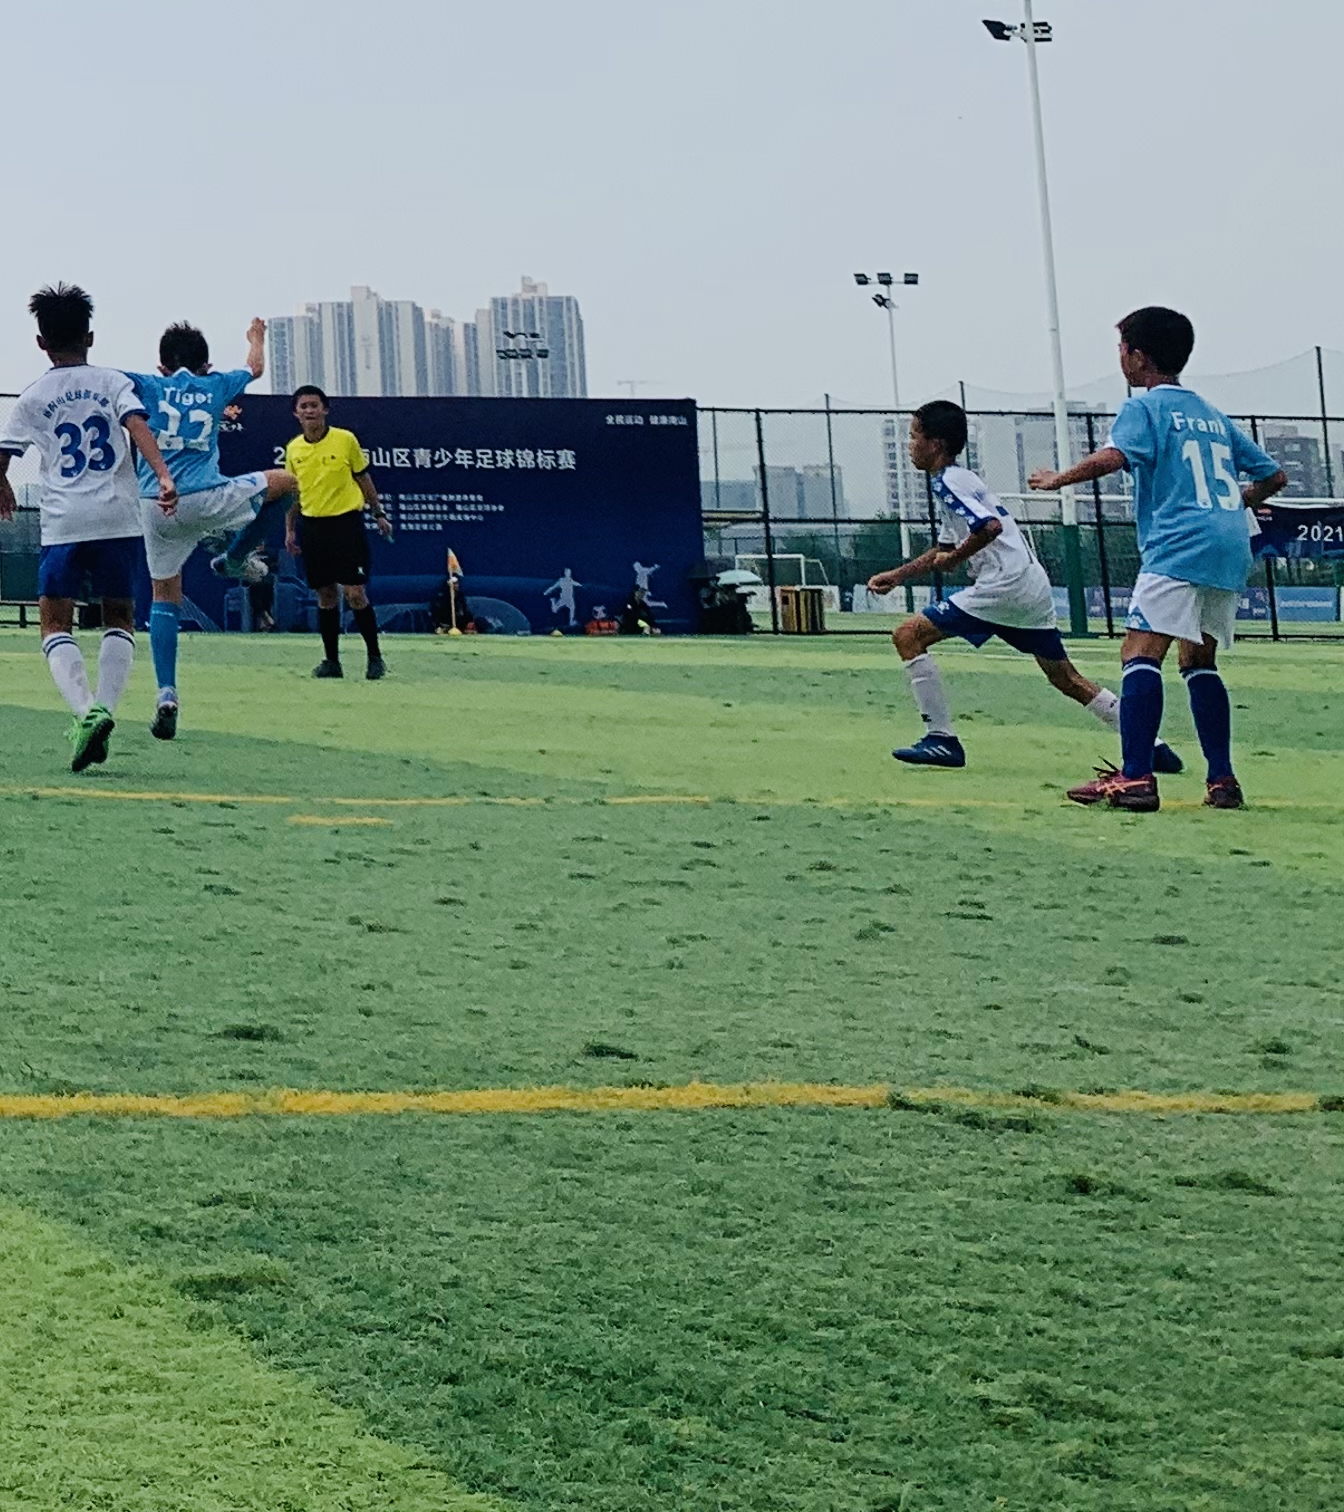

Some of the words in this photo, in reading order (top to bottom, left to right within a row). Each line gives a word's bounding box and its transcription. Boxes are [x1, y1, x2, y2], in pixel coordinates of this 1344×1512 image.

[163, 386, 214, 406] Tiger
[54, 415, 116, 478] 33
[273, 446, 577, 470] 2山区青少年足球锦标赛
[1182, 439, 1241, 511] 15
[1296, 524, 1343, 543] 2021
